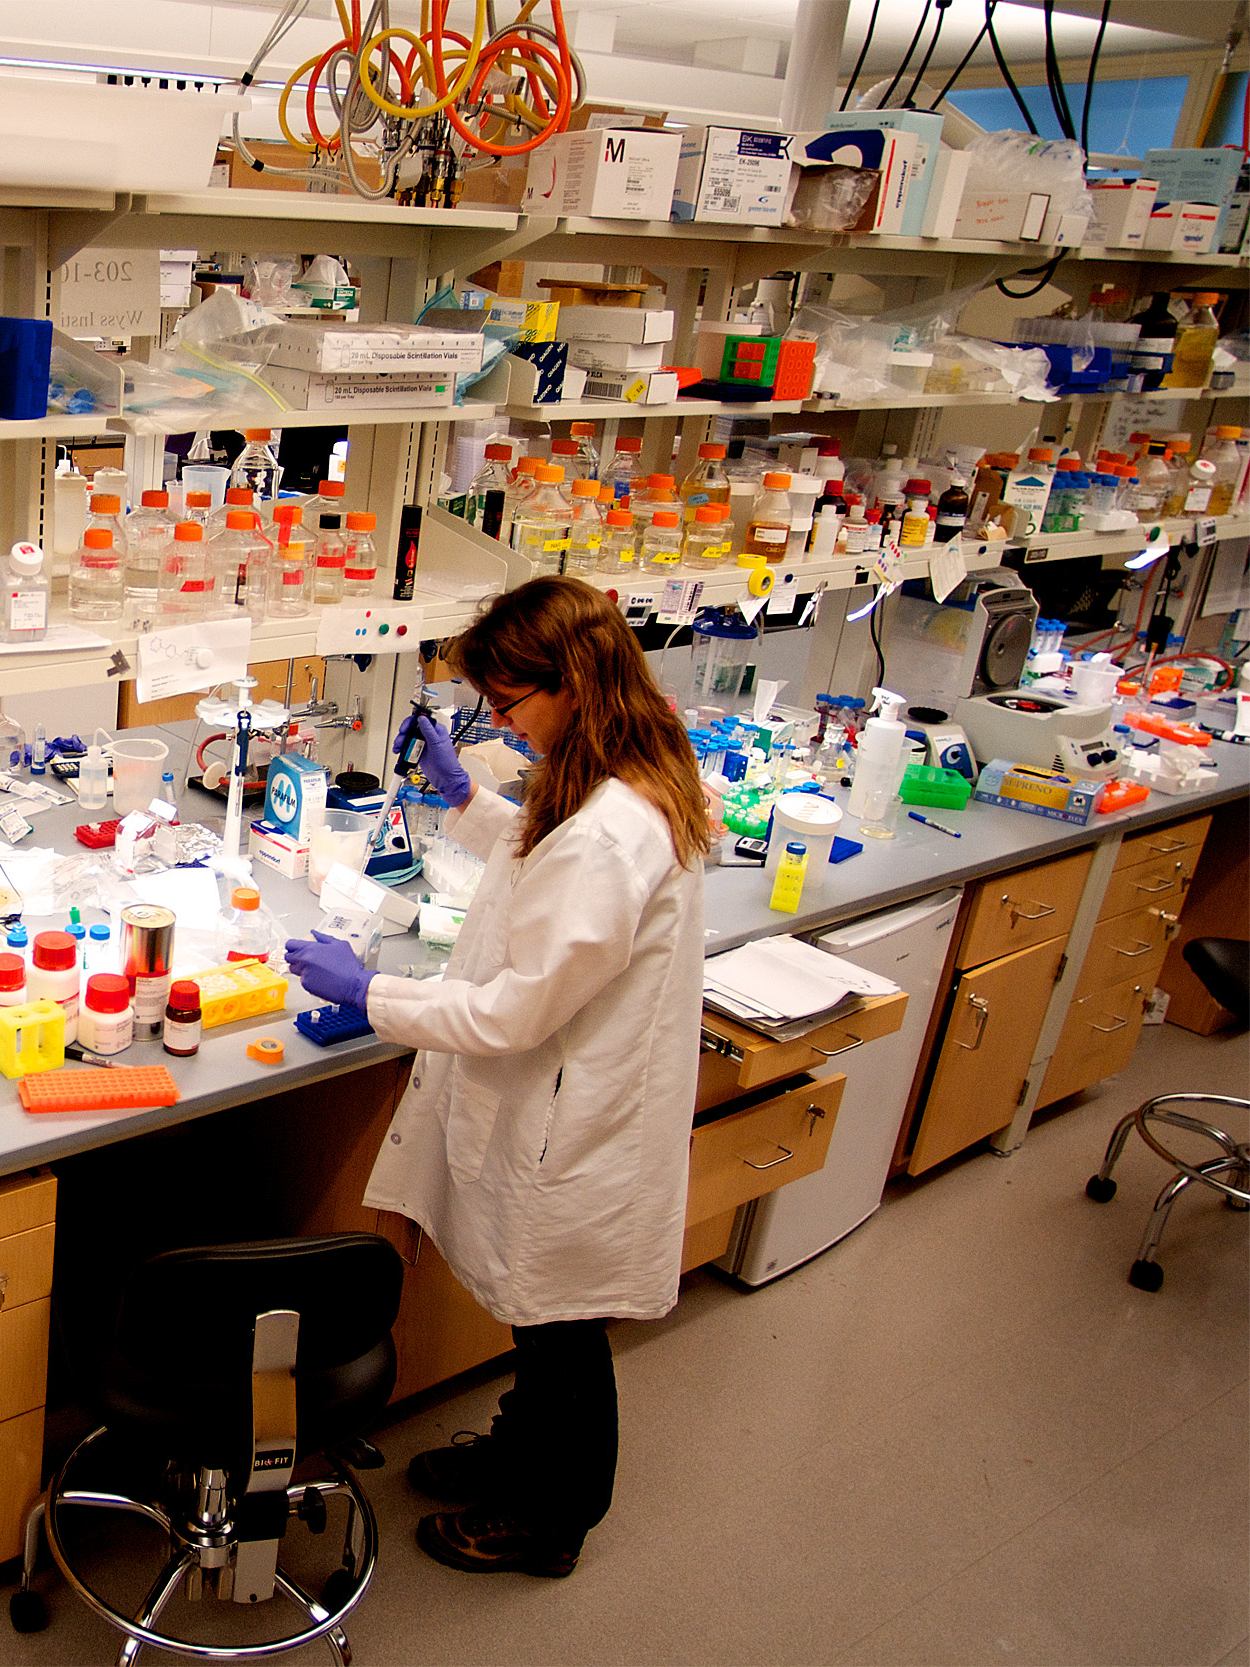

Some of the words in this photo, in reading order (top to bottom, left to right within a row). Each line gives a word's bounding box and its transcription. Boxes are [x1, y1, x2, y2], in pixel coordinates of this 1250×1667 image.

[372, 352, 406, 361] Disposable
[353, 387, 384, 396] Disposable
[1004, 779, 1052, 796] SUPRENO
[270, 786, 296, 806] PARAFILM
